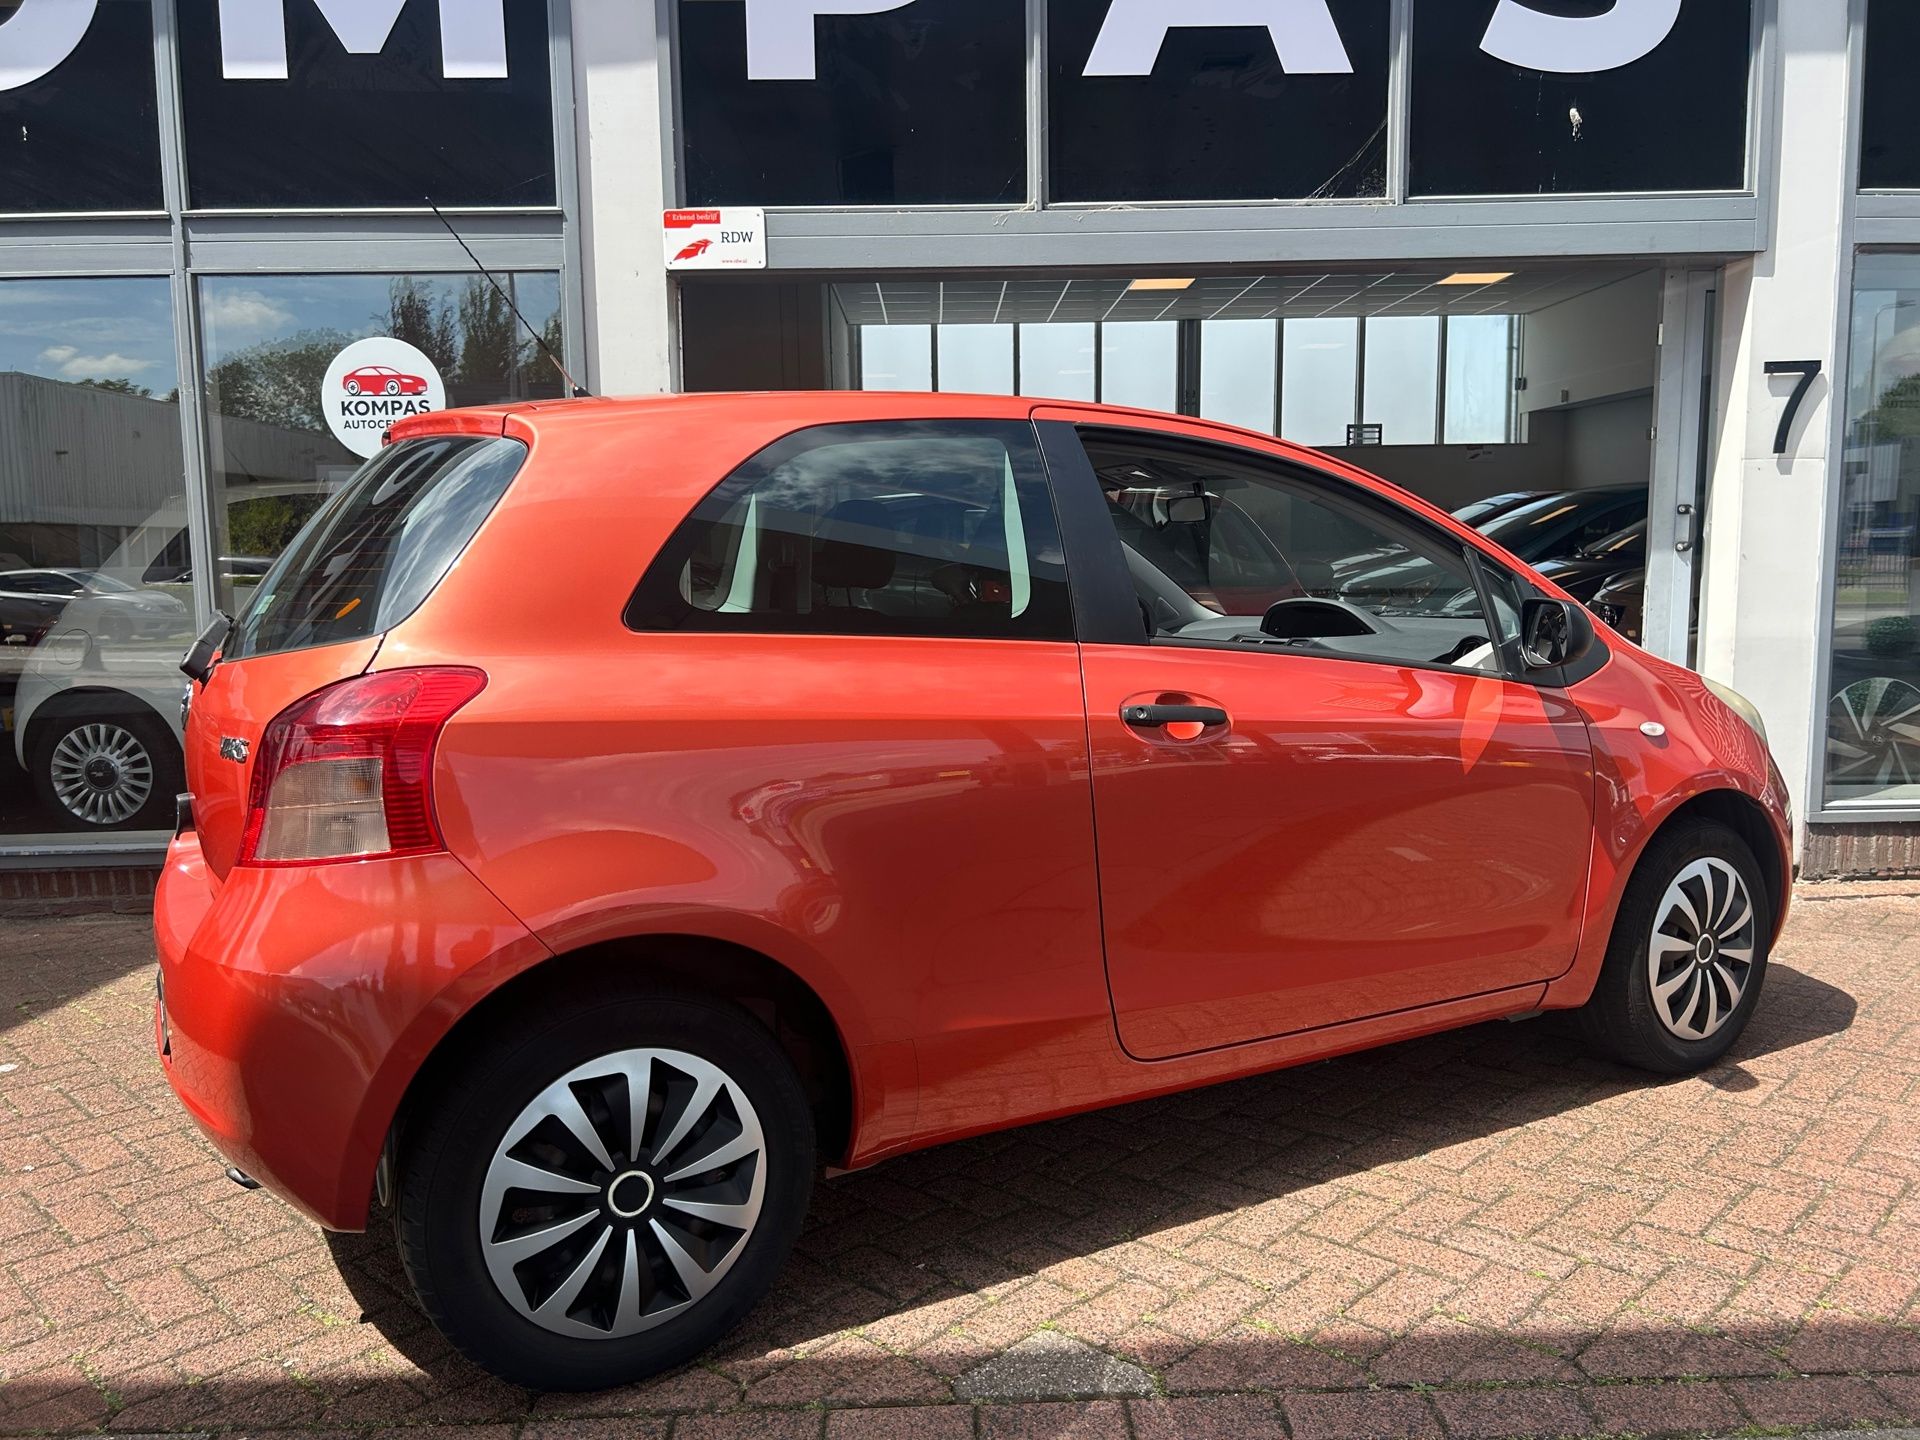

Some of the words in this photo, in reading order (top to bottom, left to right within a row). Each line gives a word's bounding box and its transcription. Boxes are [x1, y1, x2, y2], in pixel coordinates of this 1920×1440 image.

[696, 213, 717, 221] bedrijf
[720, 231, 754, 243] RDW
[341, 400, 431, 416] KOMPAS
[1763, 360, 1822, 454] 7
[343, 419, 397, 430] AUTOCE
